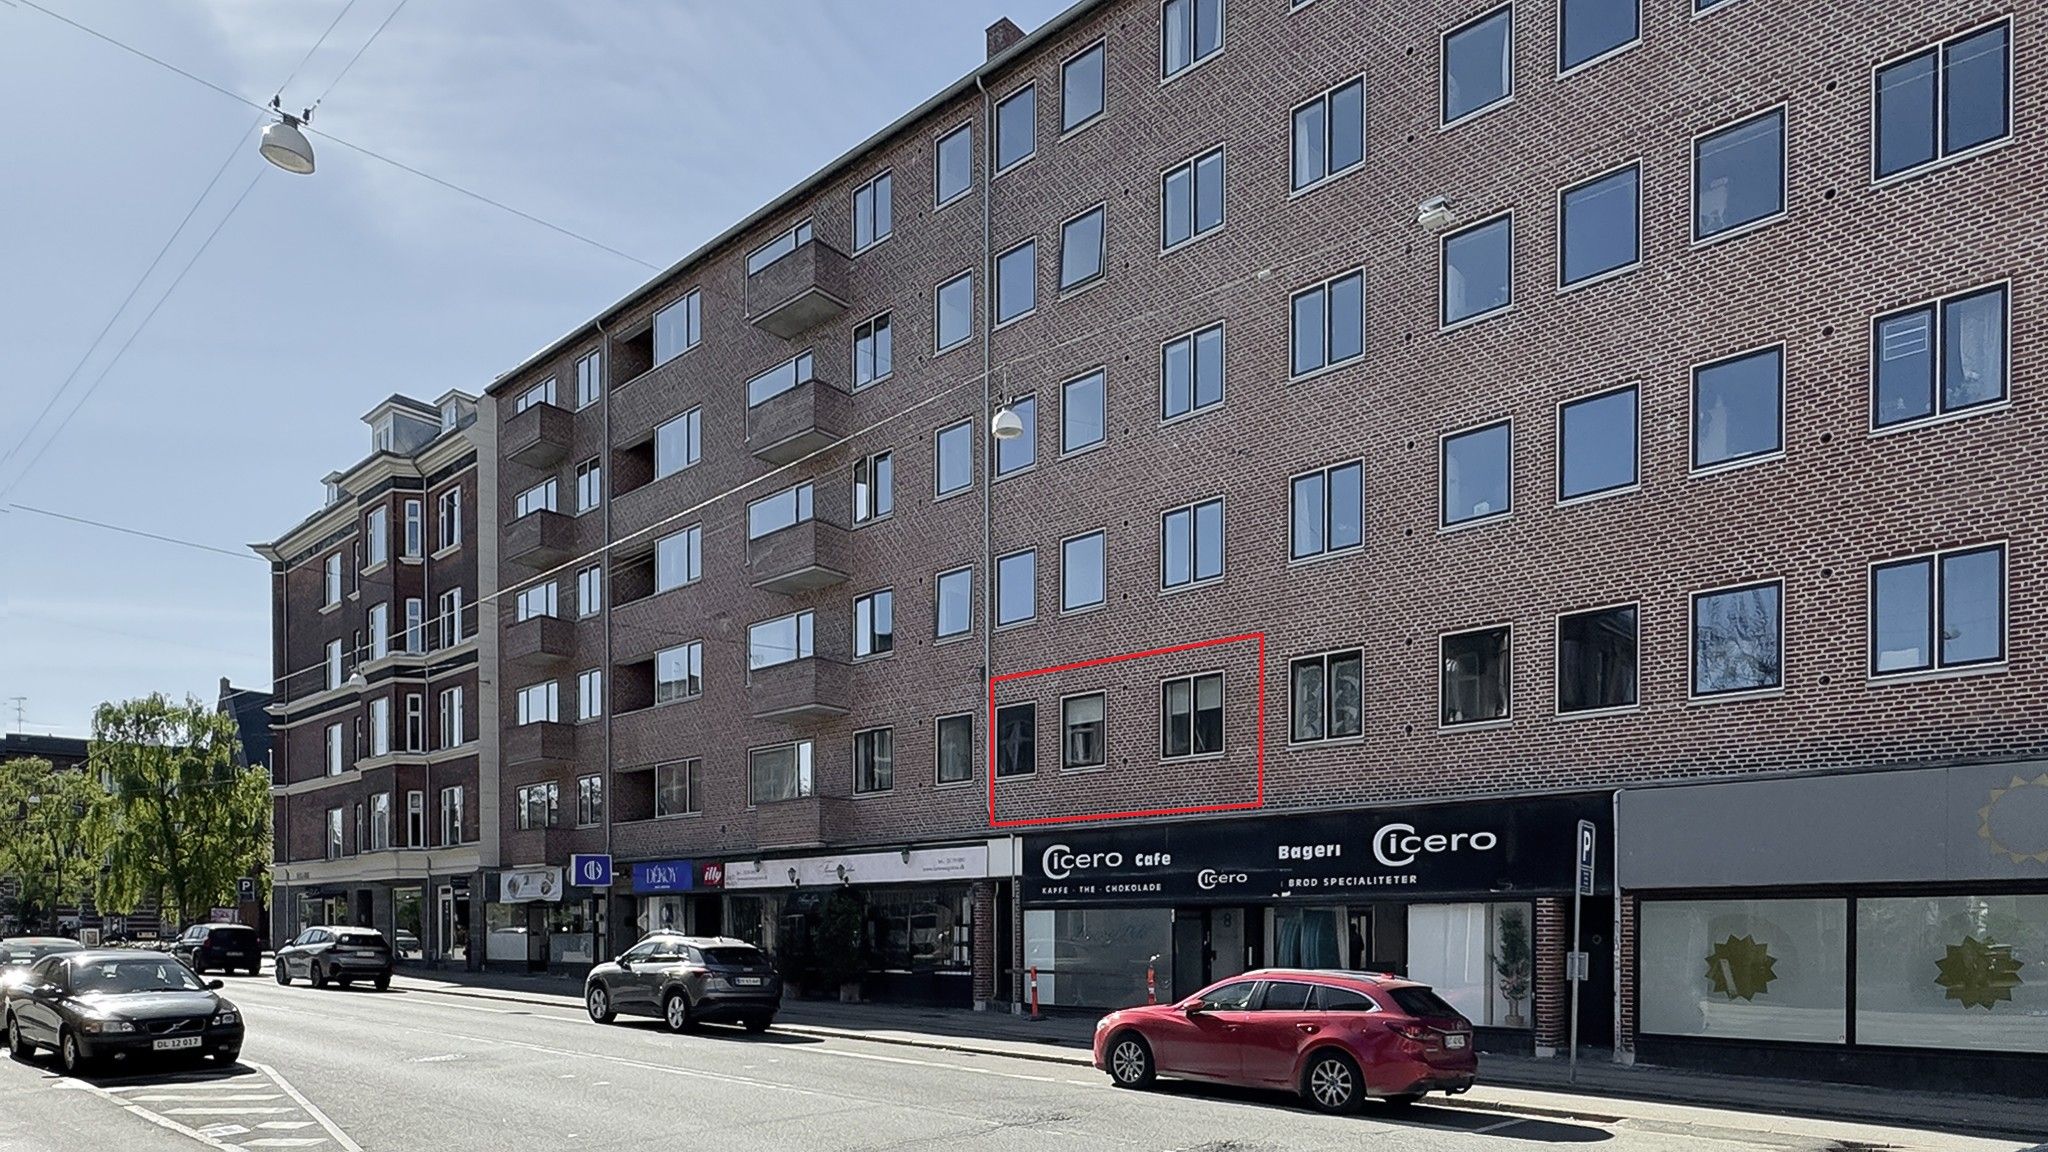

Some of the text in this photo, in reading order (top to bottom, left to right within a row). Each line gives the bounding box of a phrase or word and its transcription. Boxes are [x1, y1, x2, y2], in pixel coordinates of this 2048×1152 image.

[1278, 844, 1341, 861] Bageri
[1372, 823, 1497, 867] Cicero
[1583, 830, 1591, 862] P
[1042, 844, 1171, 880] Cicero Cafe
[704, 866, 722, 883] illy
[1197, 868, 1248, 890] Cicero
[1323, 874, 1417, 887] SPECIALITETER
[242, 881, 251, 891] P
[1105, 883, 1161, 893] CHOKOLADE
[171, 1039, 181, 1047] 12
